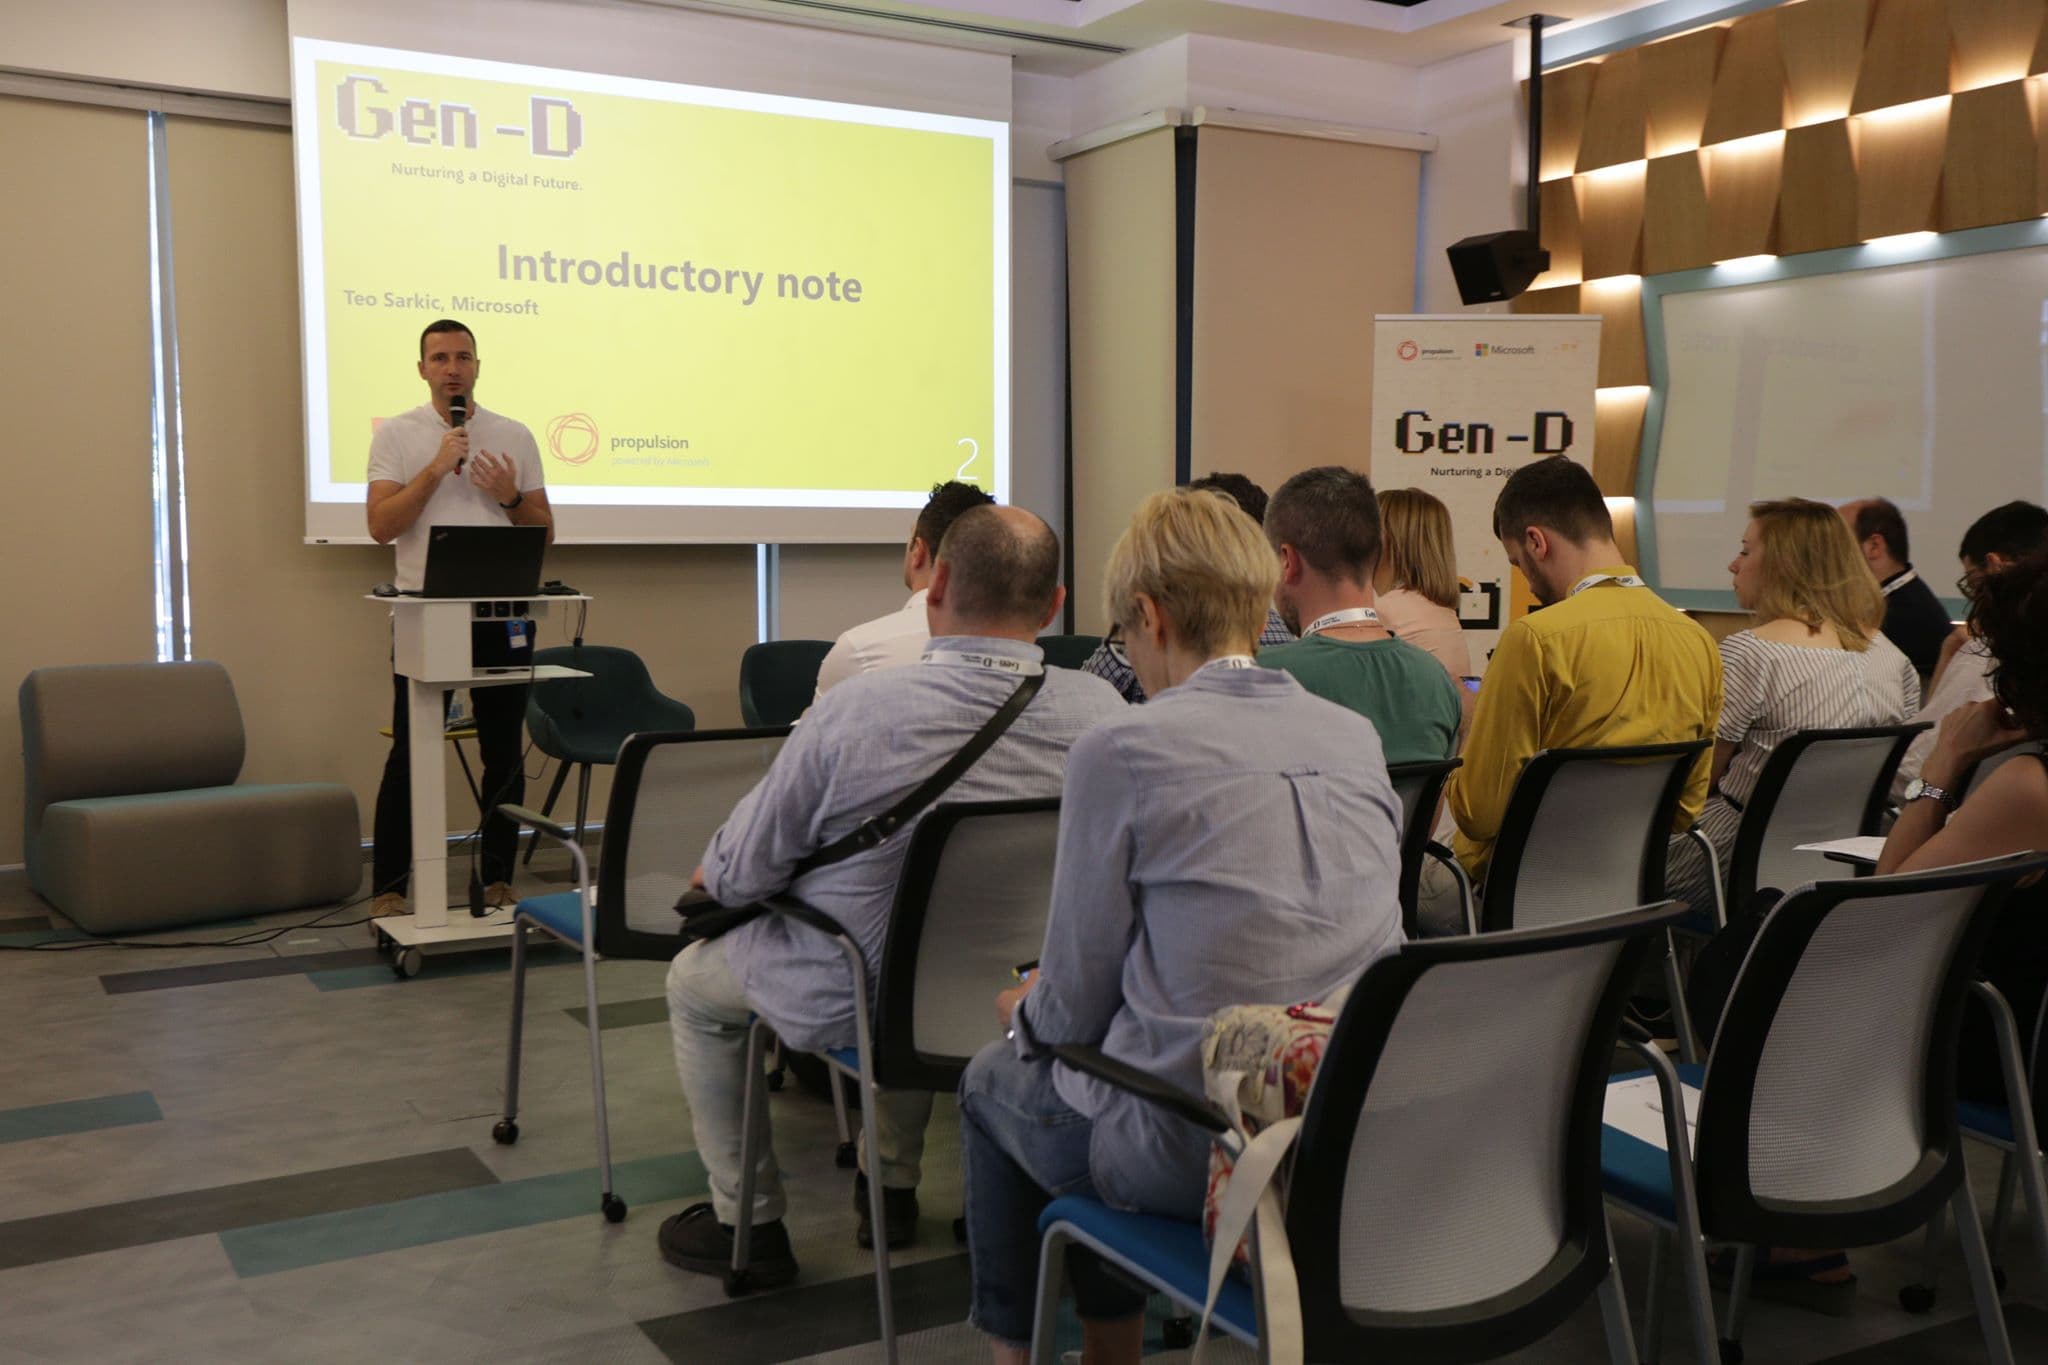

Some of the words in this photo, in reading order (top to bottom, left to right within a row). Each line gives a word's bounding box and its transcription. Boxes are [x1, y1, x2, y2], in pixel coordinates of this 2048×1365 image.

[337, 75, 477, 148] Gen
[391, 163, 465, 184] Nurturing
[468, 171, 477, 182] a
[482, 171, 529, 187] Digital
[533, 176, 582, 191] Future.
[499, 244, 764, 305] Introductory
[777, 271, 862, 303] note
[344, 290, 377, 306] Teo
[384, 292, 445, 312] Sarkic,
[452, 295, 539, 315] Microsoft
[1491, 344, 1535, 354] Microsoft
[611, 435, 689, 452] propulsion
[1396, 411, 1494, 454] Gen
[957, 438, 978, 480] 2
[1430, 468, 1482, 478] Nurturing
[999, 659, 1020, 671] Gen
